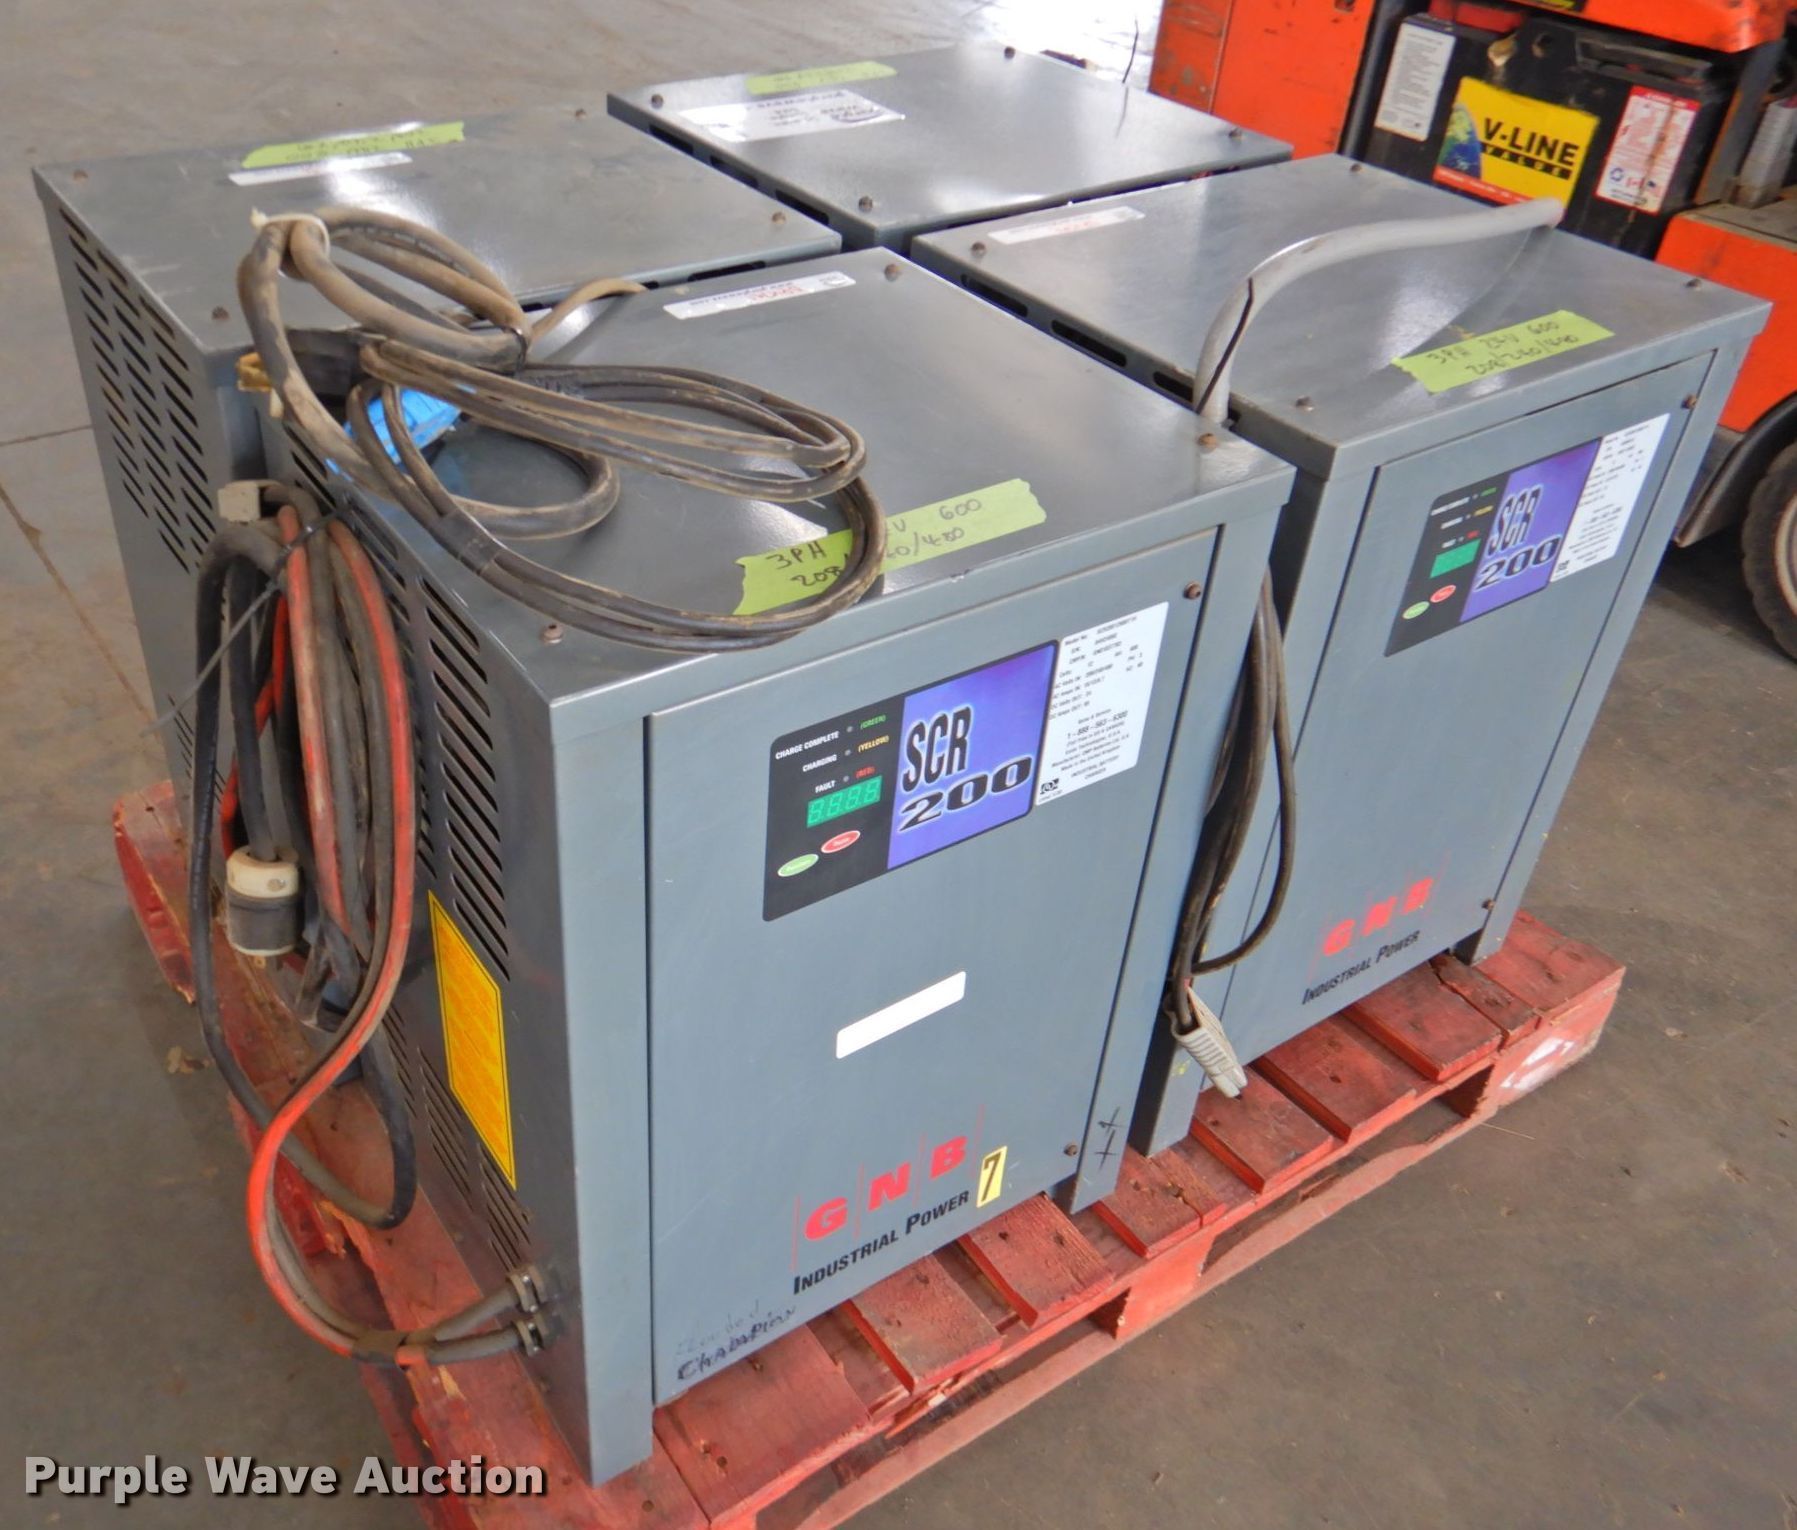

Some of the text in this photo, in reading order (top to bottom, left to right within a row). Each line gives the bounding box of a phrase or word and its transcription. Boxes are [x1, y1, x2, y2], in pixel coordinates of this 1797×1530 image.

[1484, 117, 1580, 167] V-LINE
[939, 498, 983, 521] 600
[1486, 484, 1544, 557] SCR
[1475, 533, 1562, 591] 200
[775, 743, 803, 760] CHARGE
[804, 730, 840, 750] COMPLETE
[802, 754, 838, 773] CHARGING
[901, 704, 973, 793] SCR
[815, 779, 837, 794] FAULT
[898, 755, 1034, 832] 200
[1322, 875, 1435, 958] GNB
[1302, 957, 1372, 1006] INDUSTRIAL
[803, 1135, 968, 1241] GNB
[982, 1151, 1003, 1203] 7
[793, 1190, 970, 1295] INDUSTRIAL POWER
